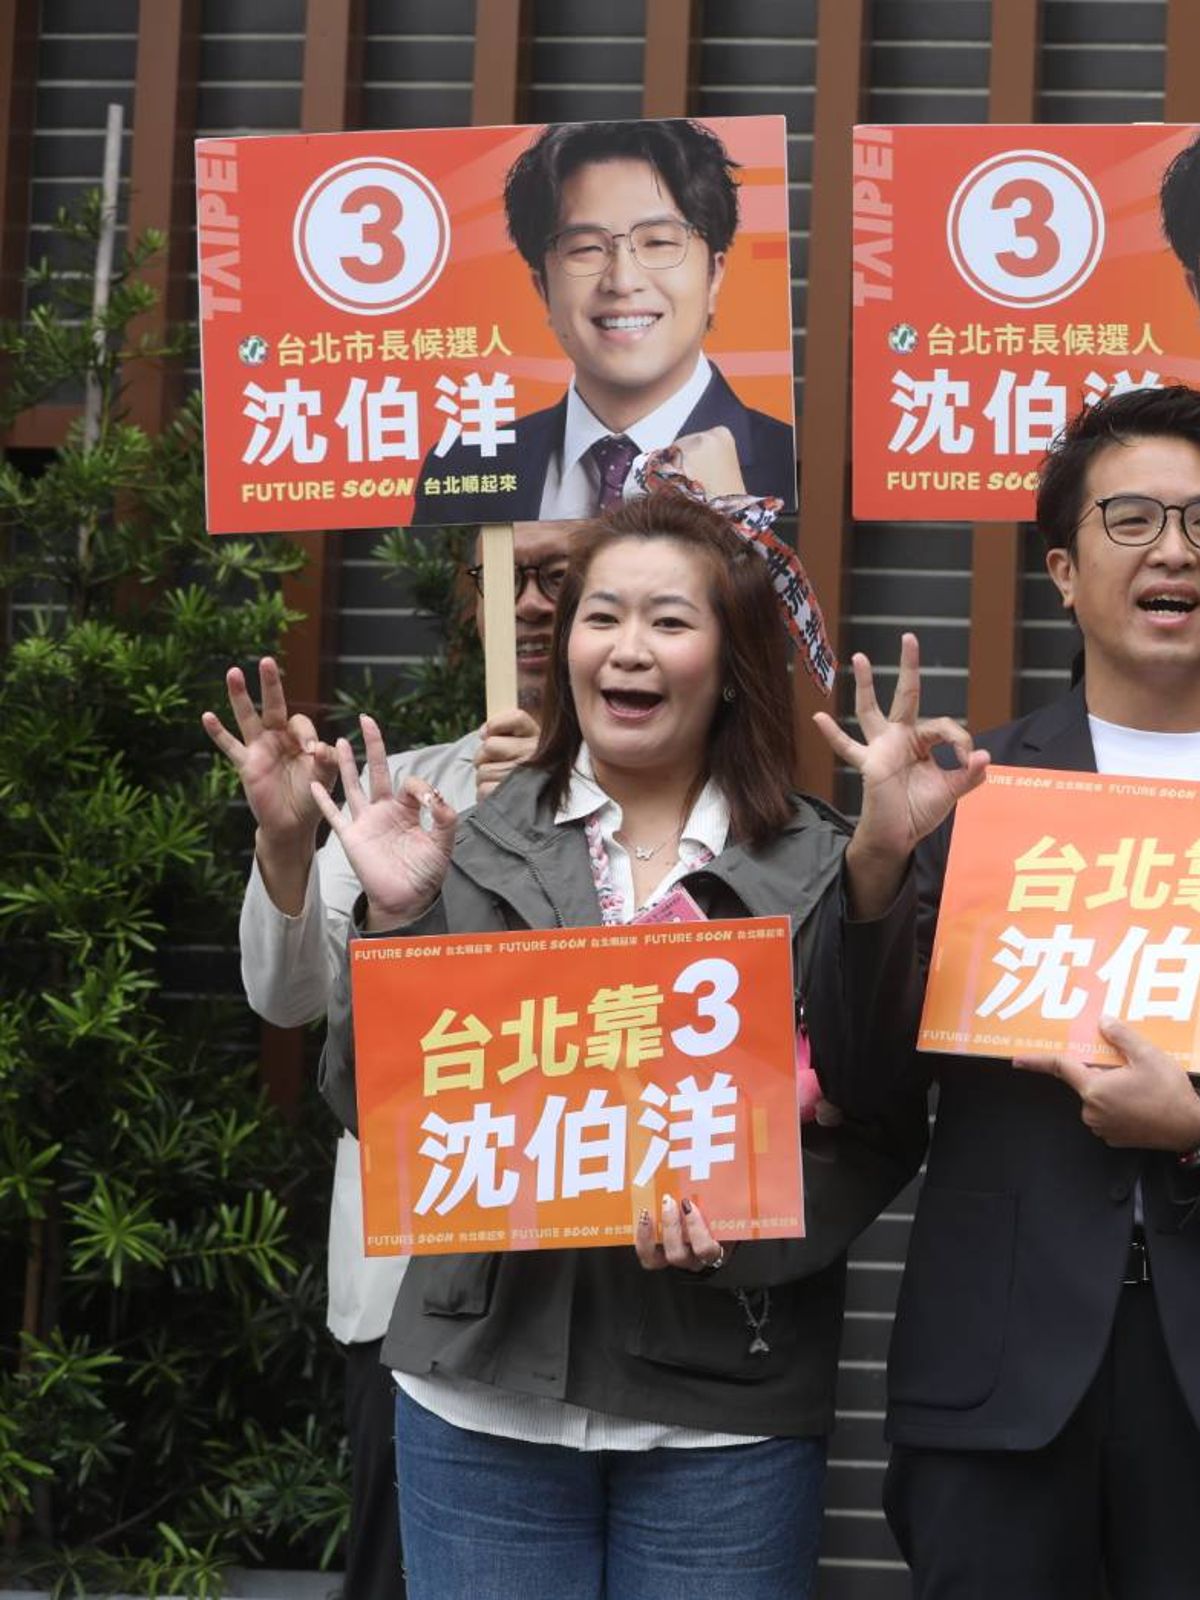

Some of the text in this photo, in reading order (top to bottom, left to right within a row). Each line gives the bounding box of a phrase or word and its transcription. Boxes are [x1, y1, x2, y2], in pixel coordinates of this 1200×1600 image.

[197, 138, 242, 321] TAIPEI
[339, 184, 407, 285] 3
[853, 126, 894, 307] TAIPEI
[990, 178, 1060, 278] 3
[277, 324, 513, 367] 台北市長候選人
[926, 323, 1164, 356] 台北市長候選人
[241, 371, 517, 467] 沈伯洋
[241, 474, 517, 503] FUTURE SOON 台北順起來
[886, 471, 1041, 491] FUTURE SOO
[1108, 783, 1157, 797] FUTURE
[354, 948, 402, 961] FUTURE
[405, 945, 442, 958] SOON
[499, 940, 547, 953] FUTURE
[550, 937, 587, 951] SOON
[644, 932, 693, 945] FUTURE
[695, 930, 732, 942] SOON
[420, 958, 740, 1096] 台北靠3
[413, 1072, 738, 1216] 沈伯洋
[368, 1234, 414, 1246] FUTURE
